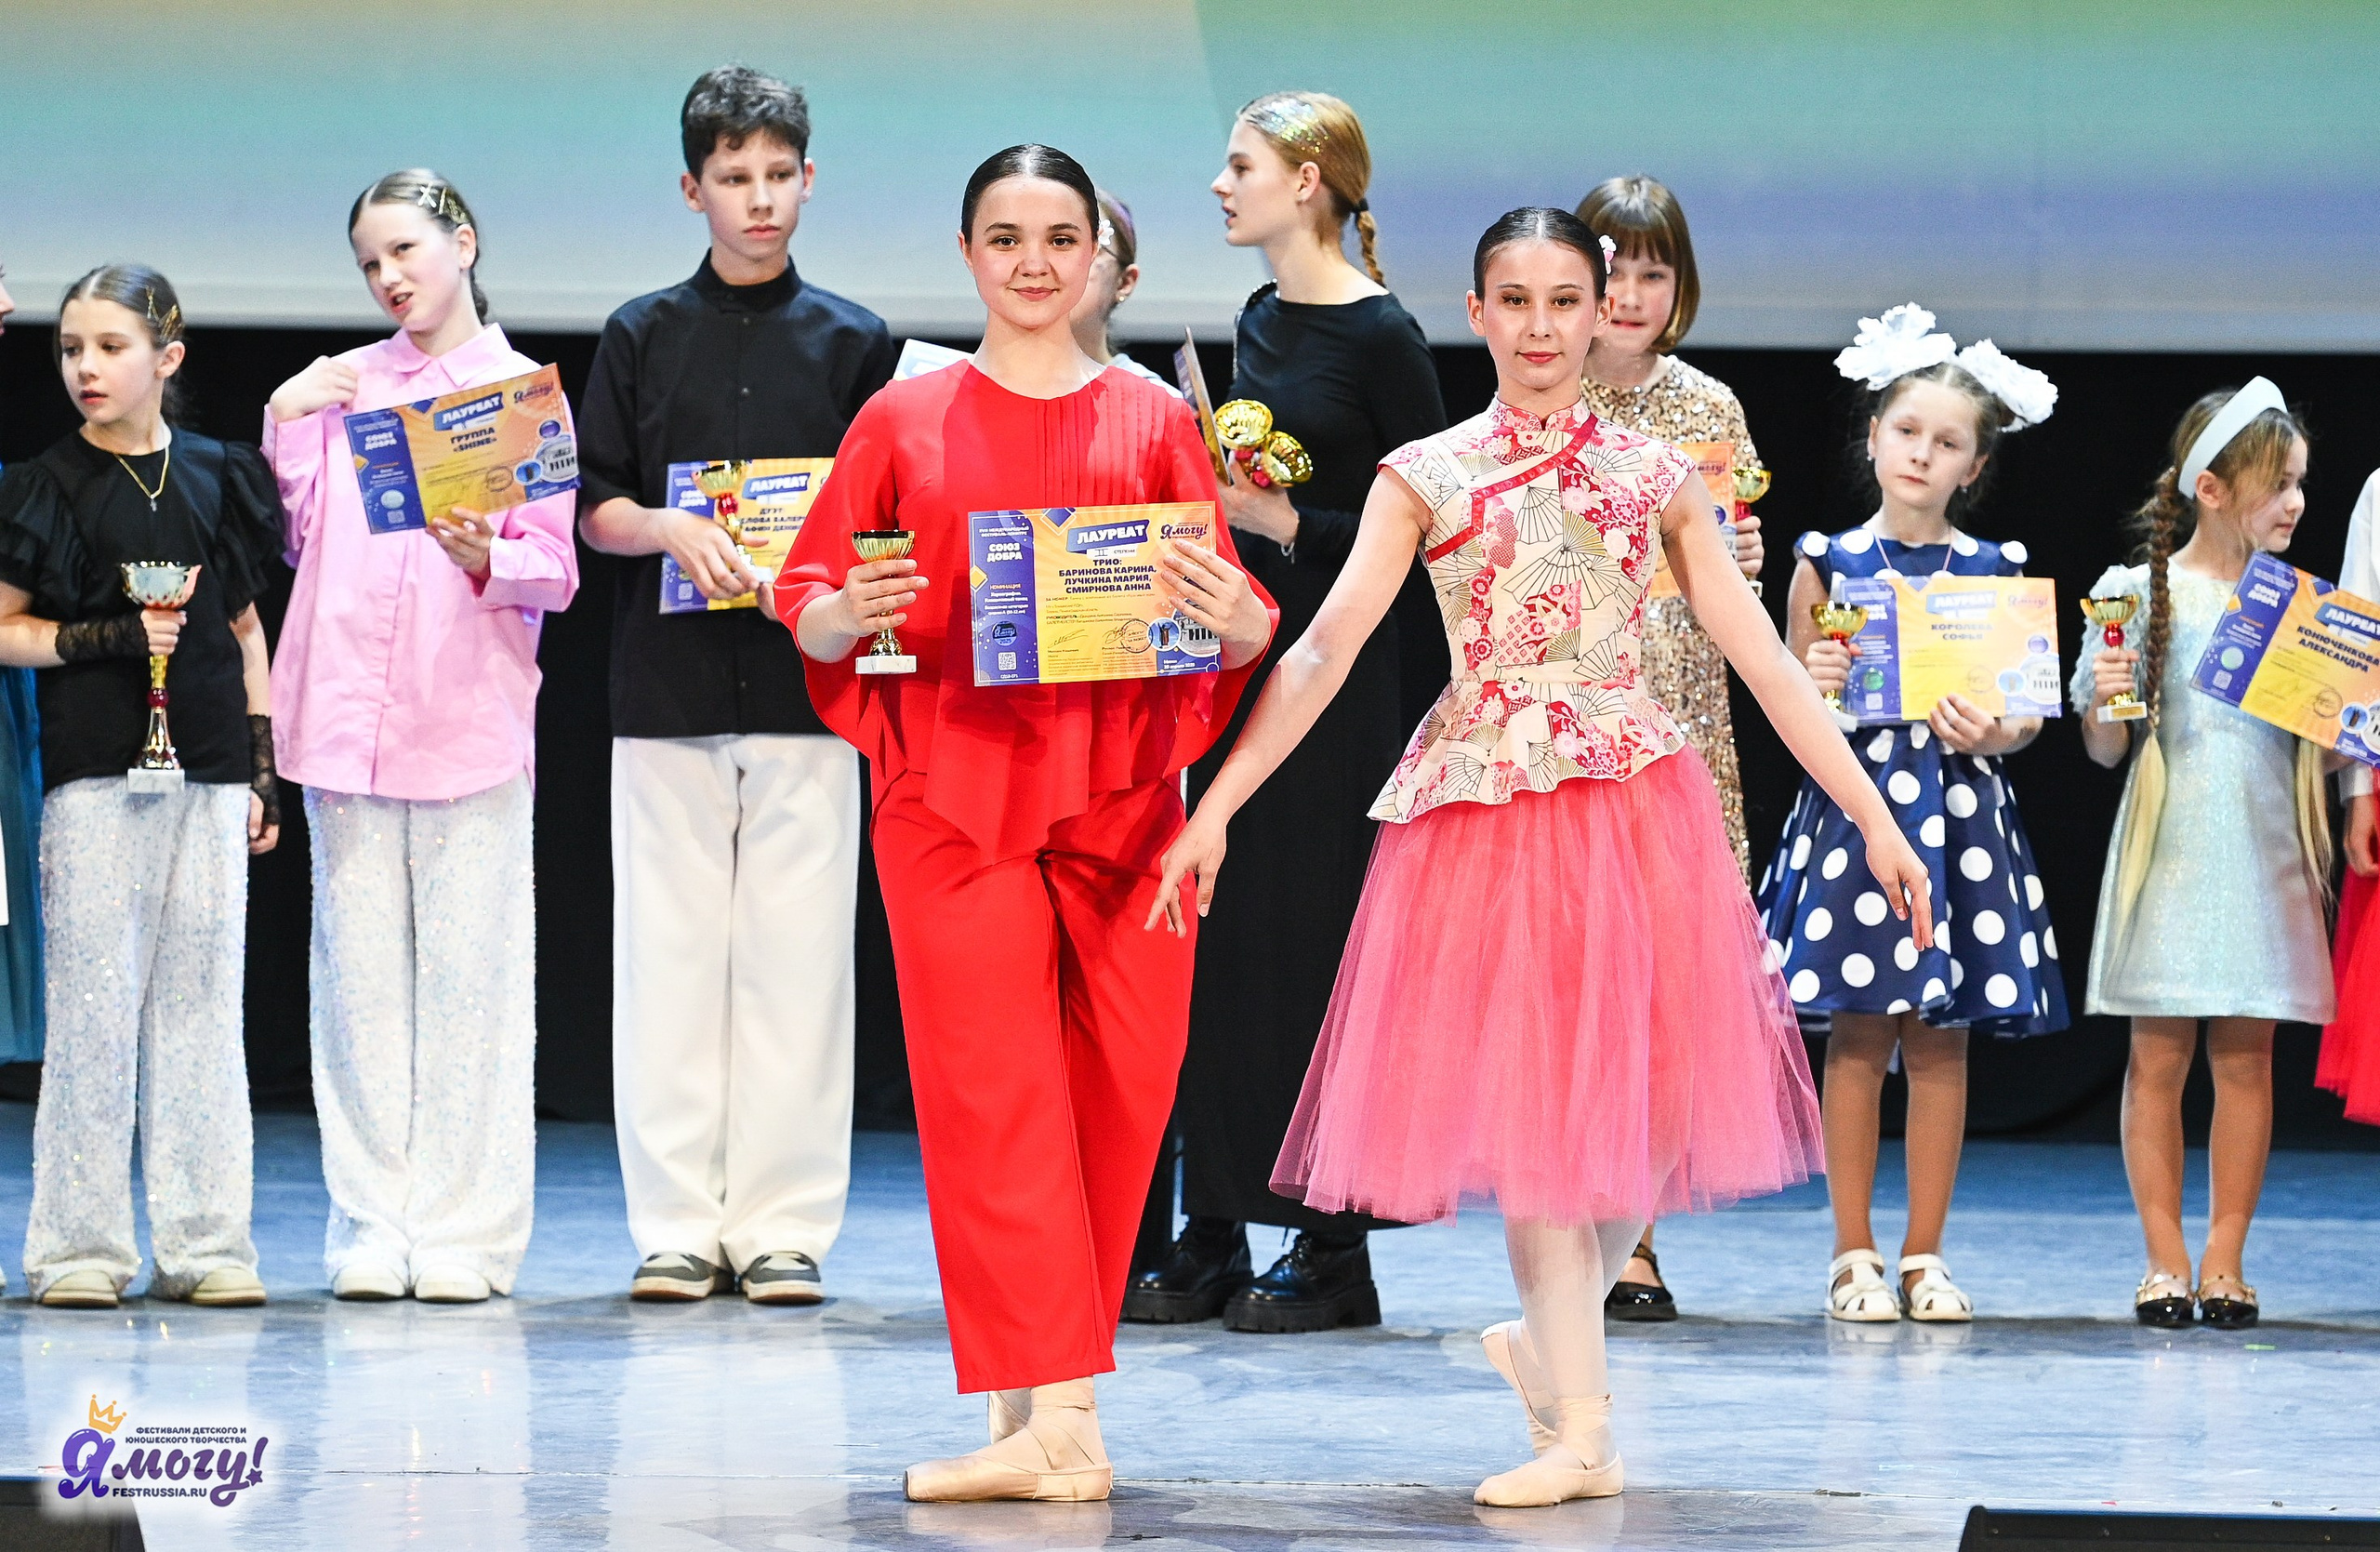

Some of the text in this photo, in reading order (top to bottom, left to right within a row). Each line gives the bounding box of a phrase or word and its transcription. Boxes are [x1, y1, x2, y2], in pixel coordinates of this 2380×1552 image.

[443, 395, 501, 424] ЛАУРЕАТ
[450, 427, 496, 444] ГРУППА
[1077, 524, 1145, 545] ЛАУРЕАТ
[988, 542, 1021, 552] СОЮЗ
[986, 551, 1024, 563] ДОБРА
[1058, 565, 1157, 577] БАРИНОВА КАРИНА,
[1064, 574, 1152, 586] ЛУЧКИНА МАРИЯ,
[1065, 583, 1152, 594] СМИРНОВА АННА
[2298, 638, 2370, 673] АЛЕКСАНДРА
